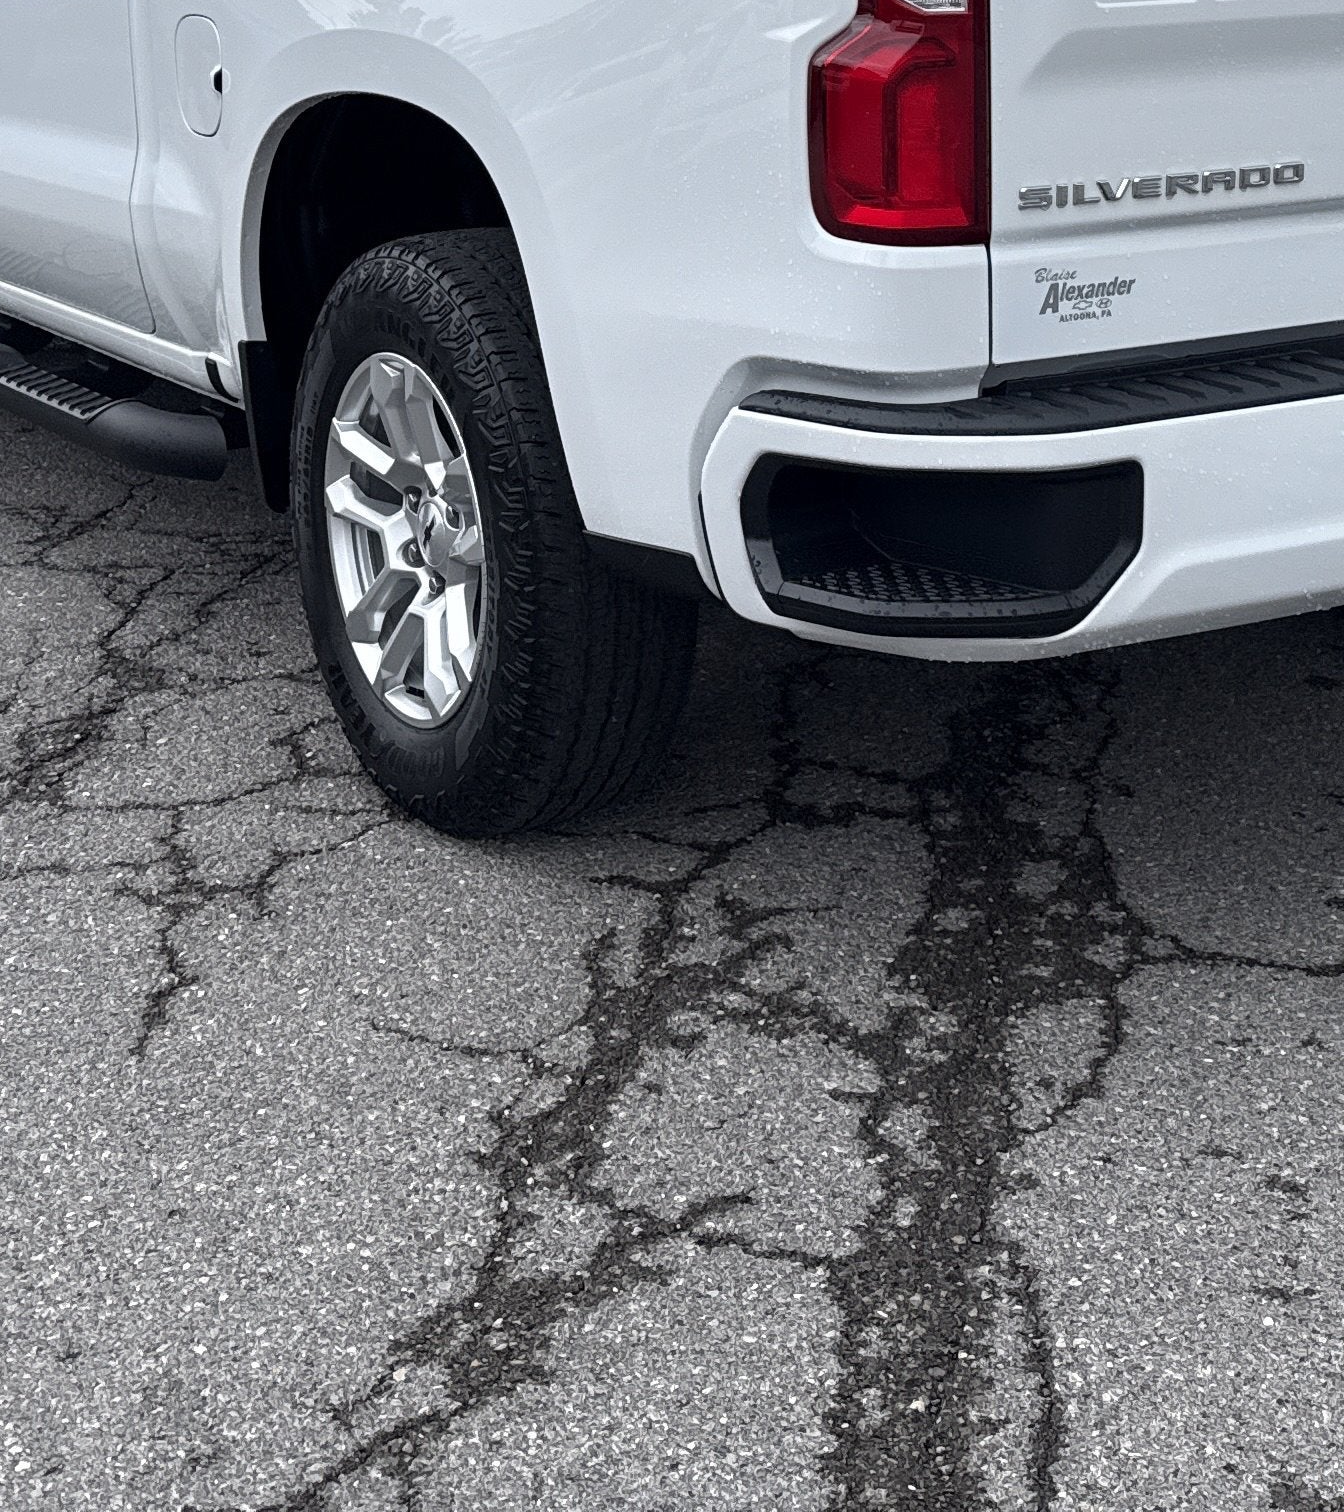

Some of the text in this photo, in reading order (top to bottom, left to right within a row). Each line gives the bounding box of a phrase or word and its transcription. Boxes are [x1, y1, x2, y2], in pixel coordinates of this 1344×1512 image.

[1018, 161, 1305, 211] SILVERADO
[1035, 268, 1077, 283] Blaise
[1039, 276, 1136, 315] Alexander
[1101, 309, 1112, 317] PA
